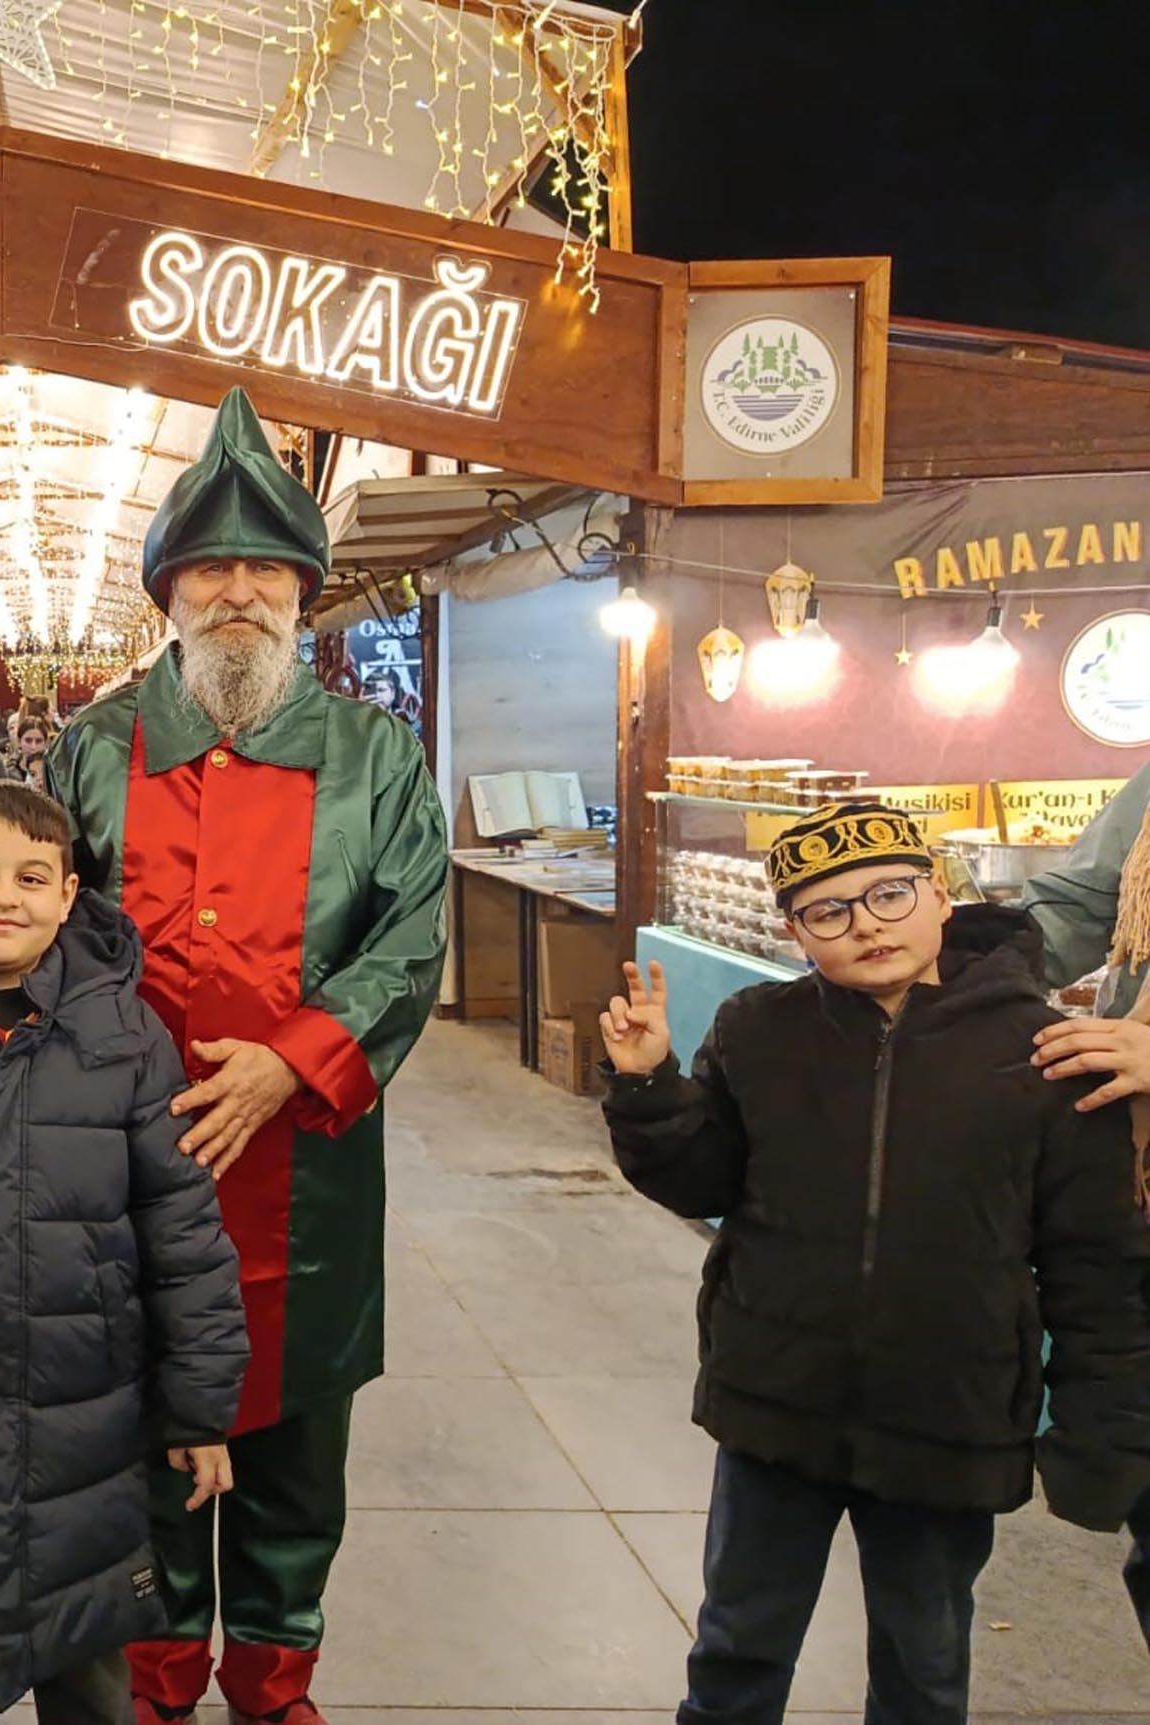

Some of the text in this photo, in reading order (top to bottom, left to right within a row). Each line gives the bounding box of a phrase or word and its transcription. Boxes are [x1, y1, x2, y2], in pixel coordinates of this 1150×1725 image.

[129, 231, 520, 411] SOKAĞI
[727, 415, 777, 443] Edirne
[893, 521, 1141, 600] RAMAZAN
